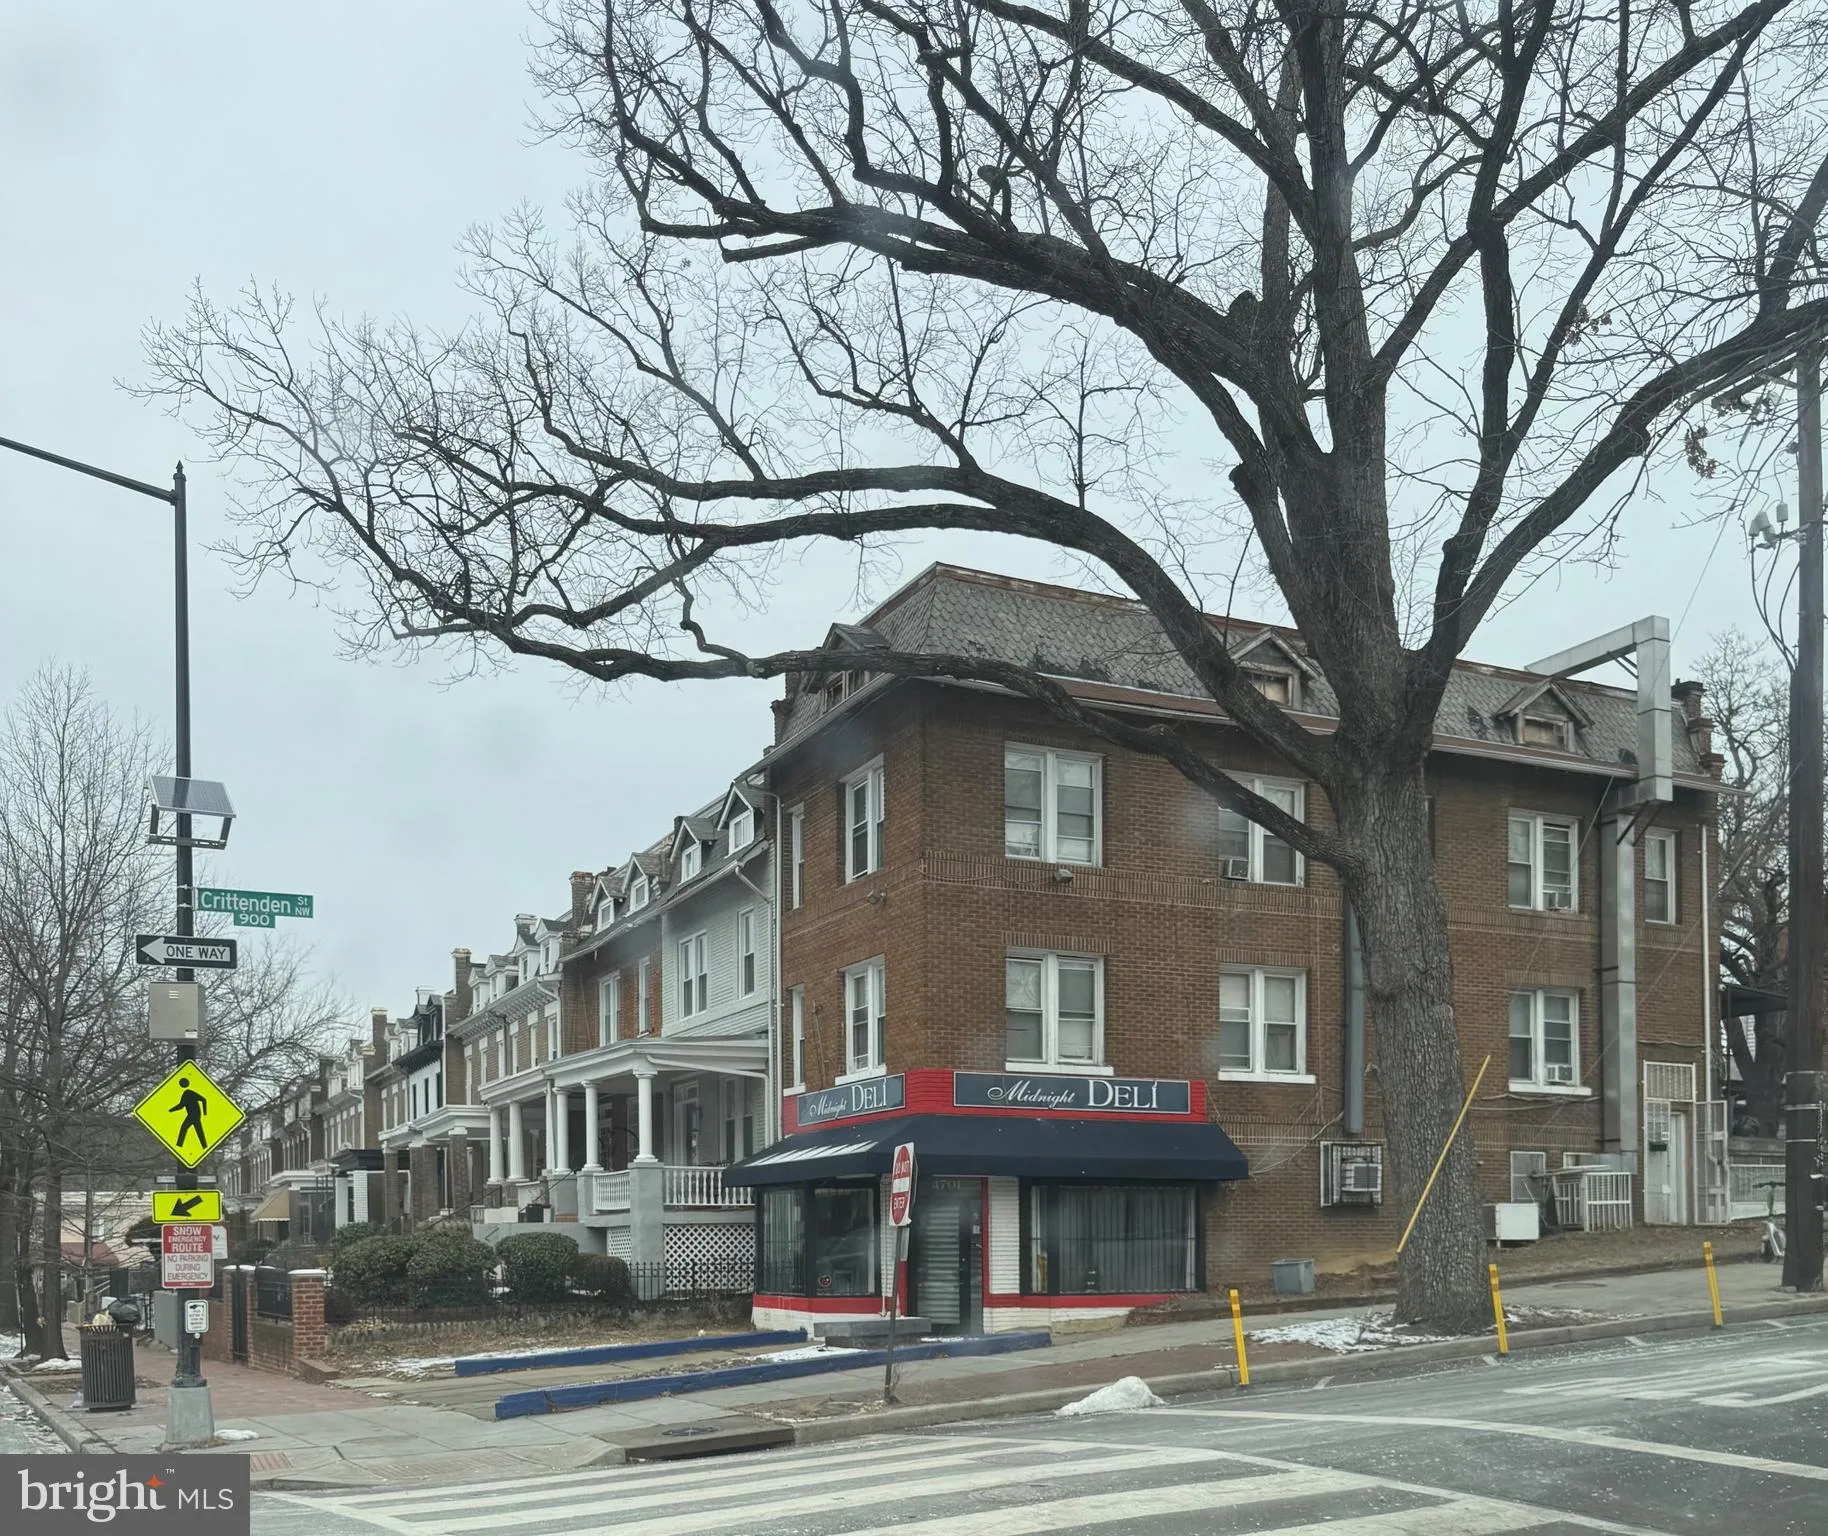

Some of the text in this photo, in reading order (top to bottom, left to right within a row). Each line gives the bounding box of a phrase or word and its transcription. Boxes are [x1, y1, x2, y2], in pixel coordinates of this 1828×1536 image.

[201, 891, 308, 914] Crittenden St
[295, 906, 310, 916] NW
[239, 913, 270, 926] 900
[166, 945, 226, 960] ONE WAY
[987, 1080, 1075, 1108] Midnight
[810, 1095, 847, 1119] Midnight
[894, 1197, 905, 1209] ENTER
[173, 1226, 202, 1236] SNOW
[172, 1243, 204, 1252] ROUTE
[175, 1264, 201, 1272] DURING
[167, 1273, 209, 1281] EMERGENCY
